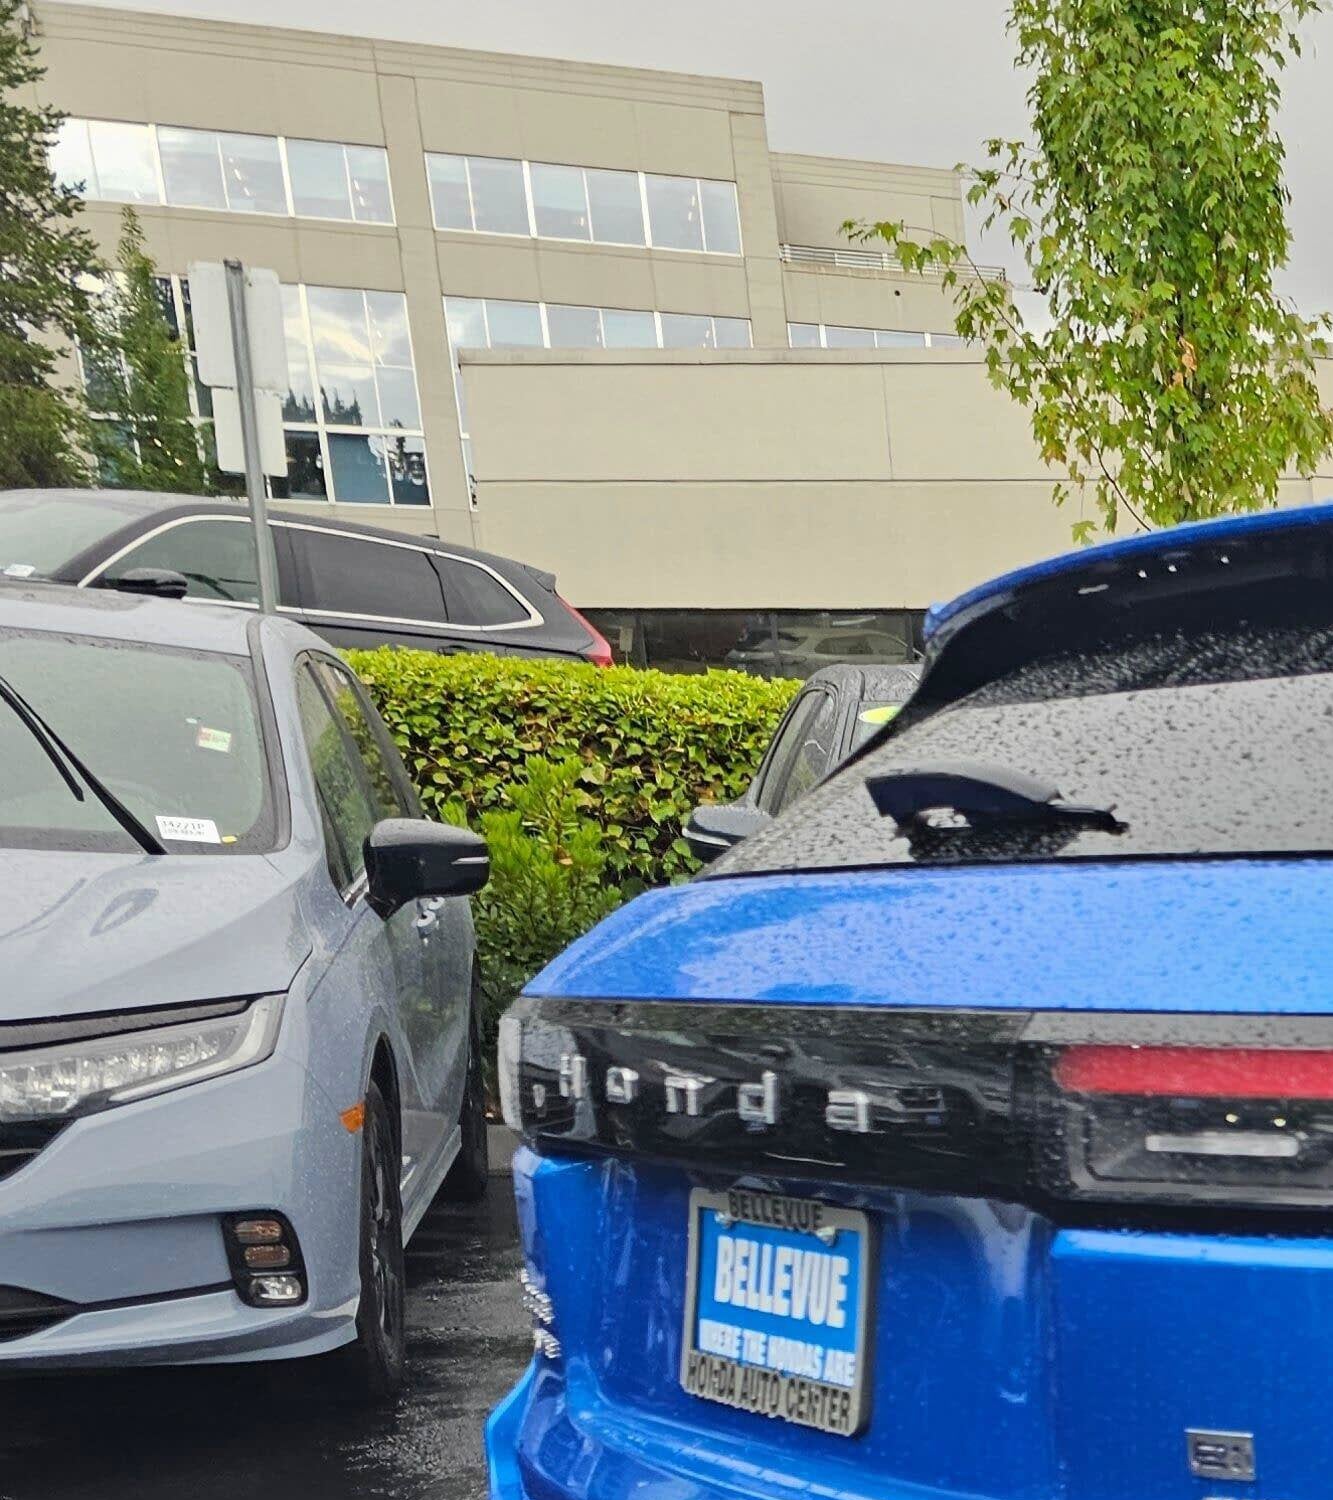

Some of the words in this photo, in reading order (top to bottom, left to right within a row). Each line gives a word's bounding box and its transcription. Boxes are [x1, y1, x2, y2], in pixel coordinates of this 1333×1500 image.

[729, 1189, 823, 1231] BELLEVUE
[714, 1235, 849, 1329] BELLEVUE
[687, 1352, 737, 1398] HONDA
[740, 1365, 781, 1412] AUTO
[785, 1377, 851, 1432] CENTER
